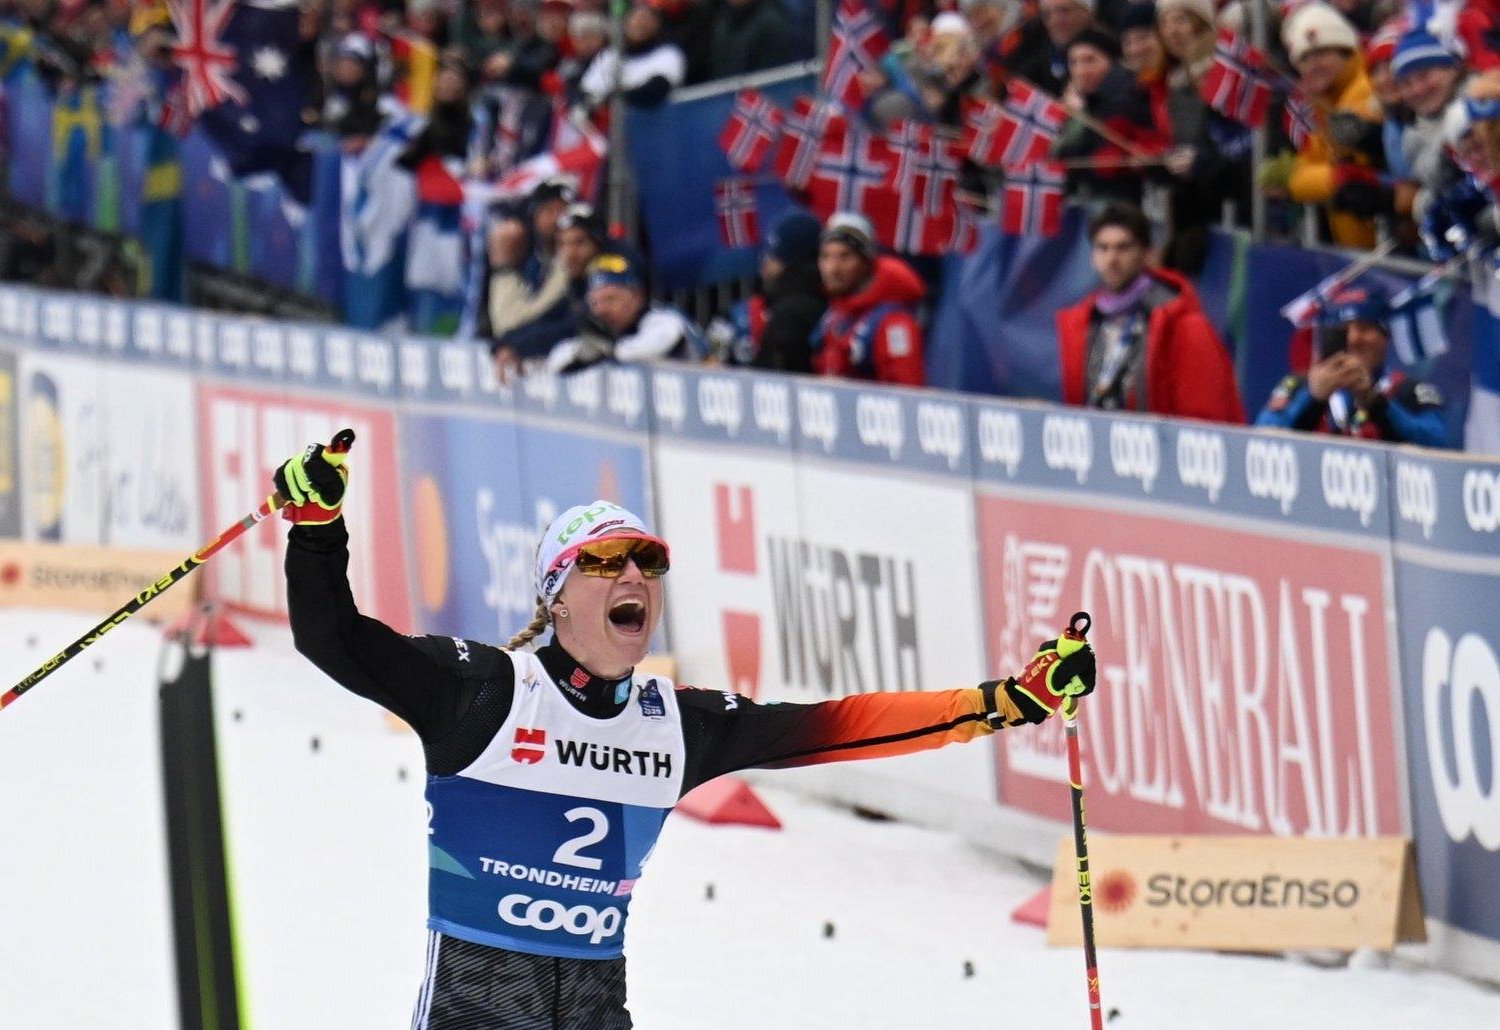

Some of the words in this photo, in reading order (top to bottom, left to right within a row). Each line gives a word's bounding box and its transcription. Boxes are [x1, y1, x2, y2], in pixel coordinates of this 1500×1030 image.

[1042, 413, 1093, 485] coop
[1109, 420, 1159, 494] coop
[1177, 429, 1227, 504] coop
[1245, 438, 1298, 515] coop
[1321, 448, 1377, 528] coop
[1082, 549, 1377, 838] GENERALI
[555, 739, 672, 779] WÜRTH
[552, 806, 609, 871] 2
[479, 856, 616, 894] TRONDHEIM
[1147, 872, 1360, 909] StoraEnso
[497, 893, 622, 944] coop
